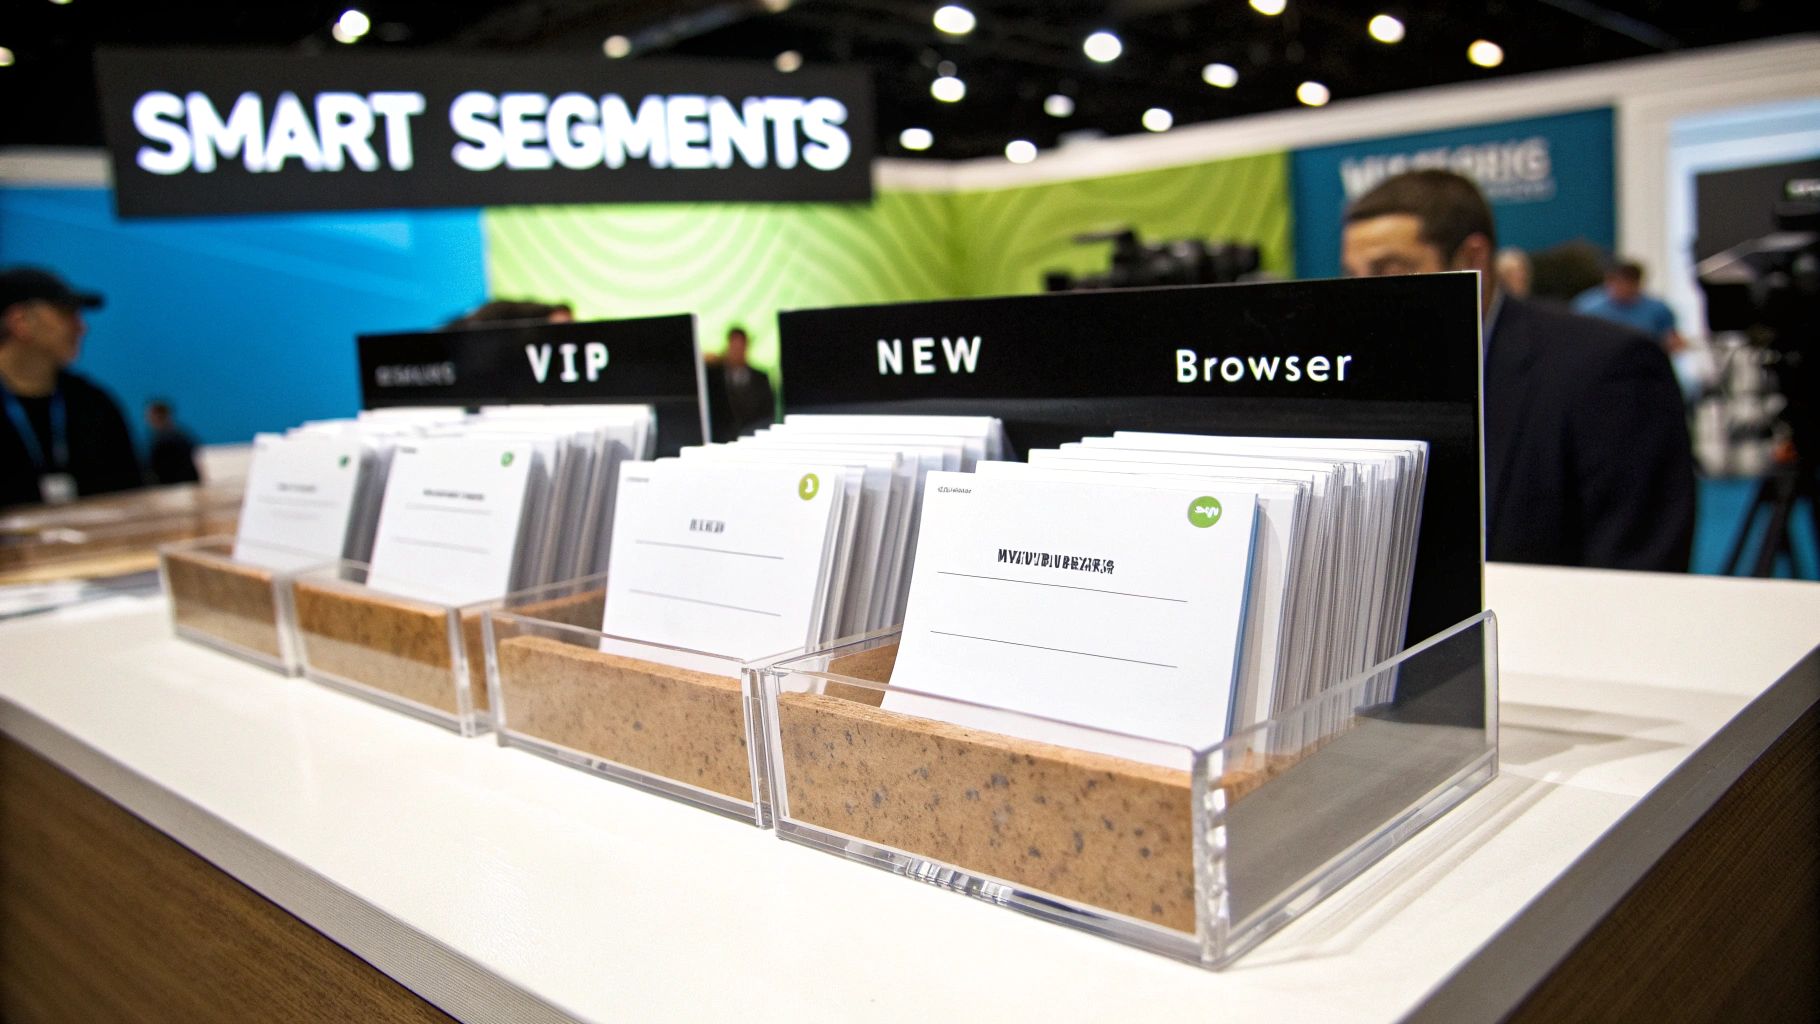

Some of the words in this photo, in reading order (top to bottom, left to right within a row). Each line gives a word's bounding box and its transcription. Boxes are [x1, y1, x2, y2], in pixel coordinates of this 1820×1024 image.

[133, 92, 425, 174] SMART
[449, 92, 851, 171] SEGMENTS
[526, 343, 609, 383] VIP
[877, 336, 982, 375] NEW
[1176, 349, 1352, 383] Browser
